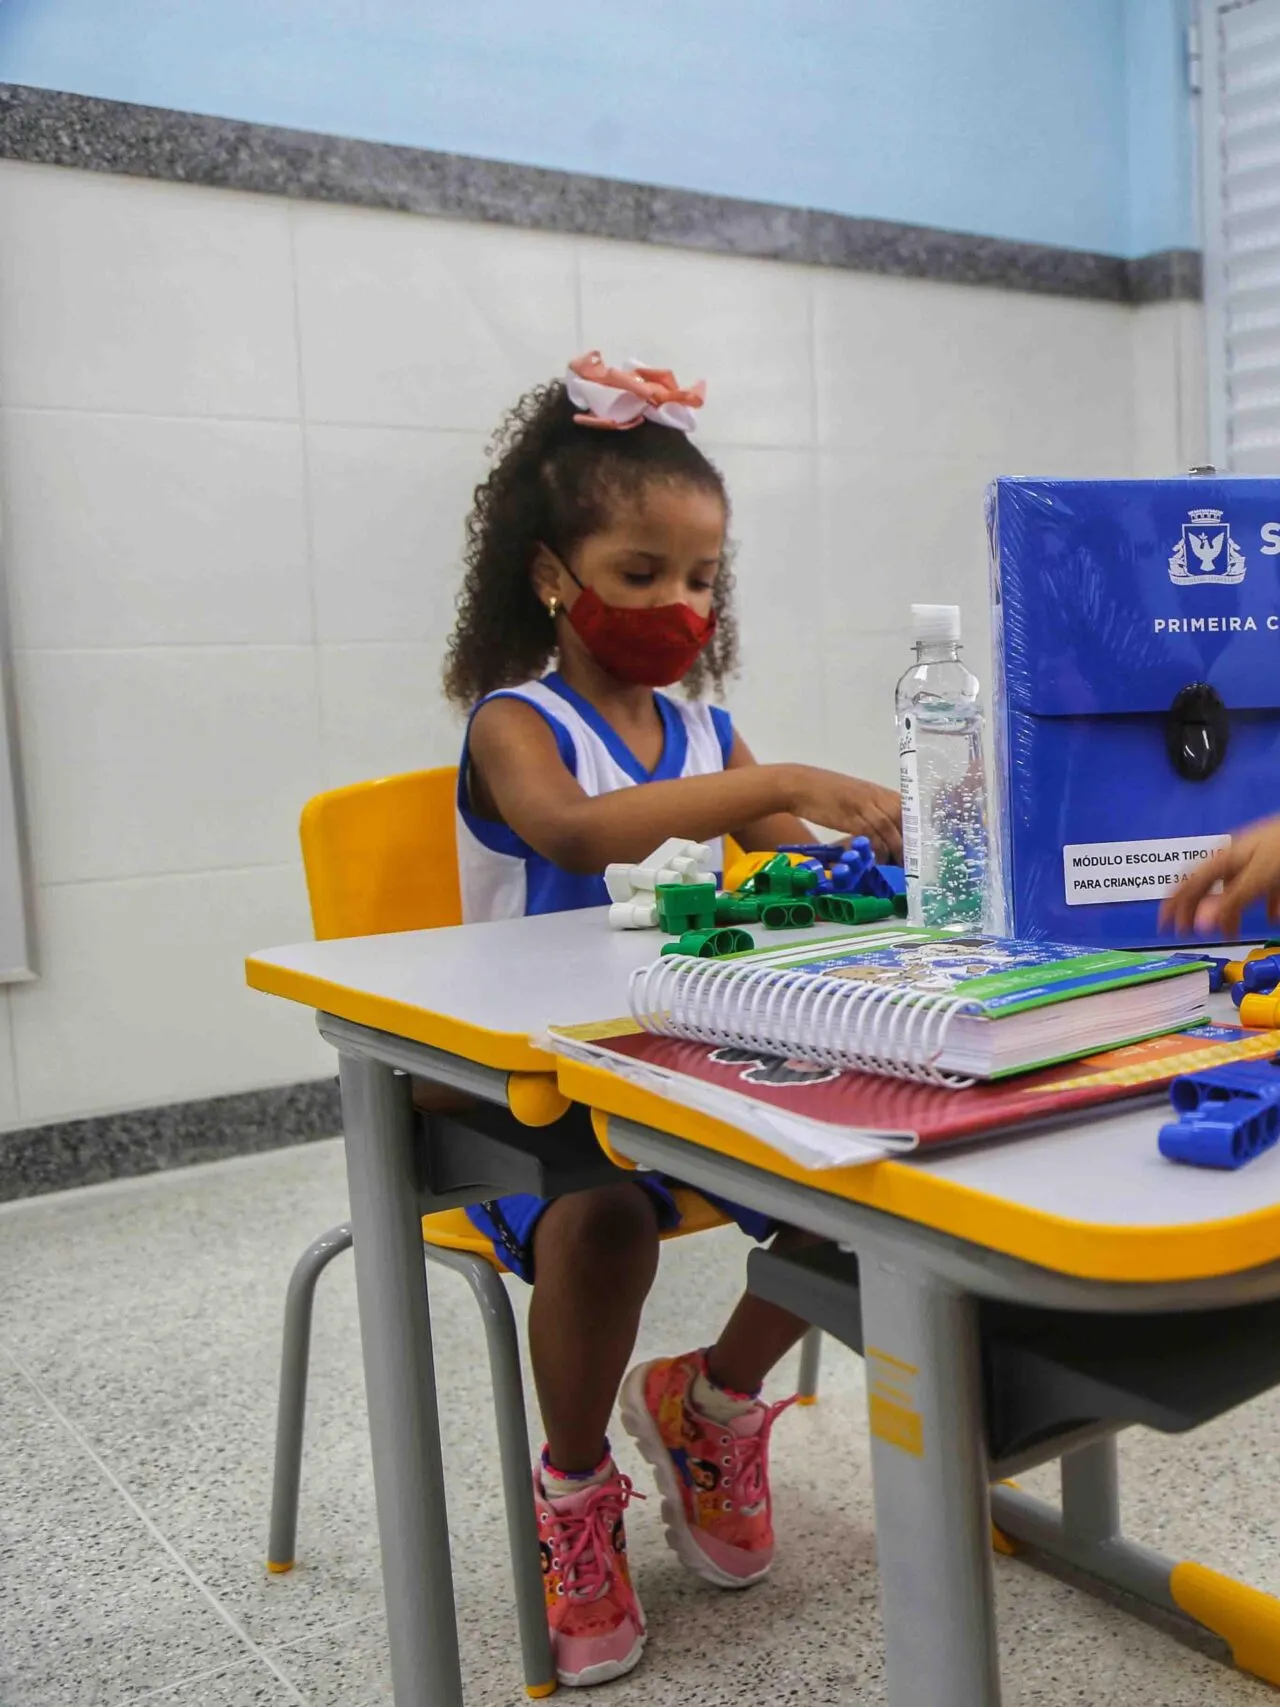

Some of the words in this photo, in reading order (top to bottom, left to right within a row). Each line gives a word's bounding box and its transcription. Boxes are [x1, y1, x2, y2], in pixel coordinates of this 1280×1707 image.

[1154, 615, 1257, 634] PRIMEIRA
[1072, 854, 1123, 868] MÓDULO
[1125, 851, 1180, 865] ESCOLAR
[1182, 849, 1208, 862] TIPO
[1073, 878, 1102, 890] PARA
[1103, 875, 1155, 889] CRIANÇAS
[1157, 874, 1172, 884] DE
[1174, 873, 1180, 884] 3
